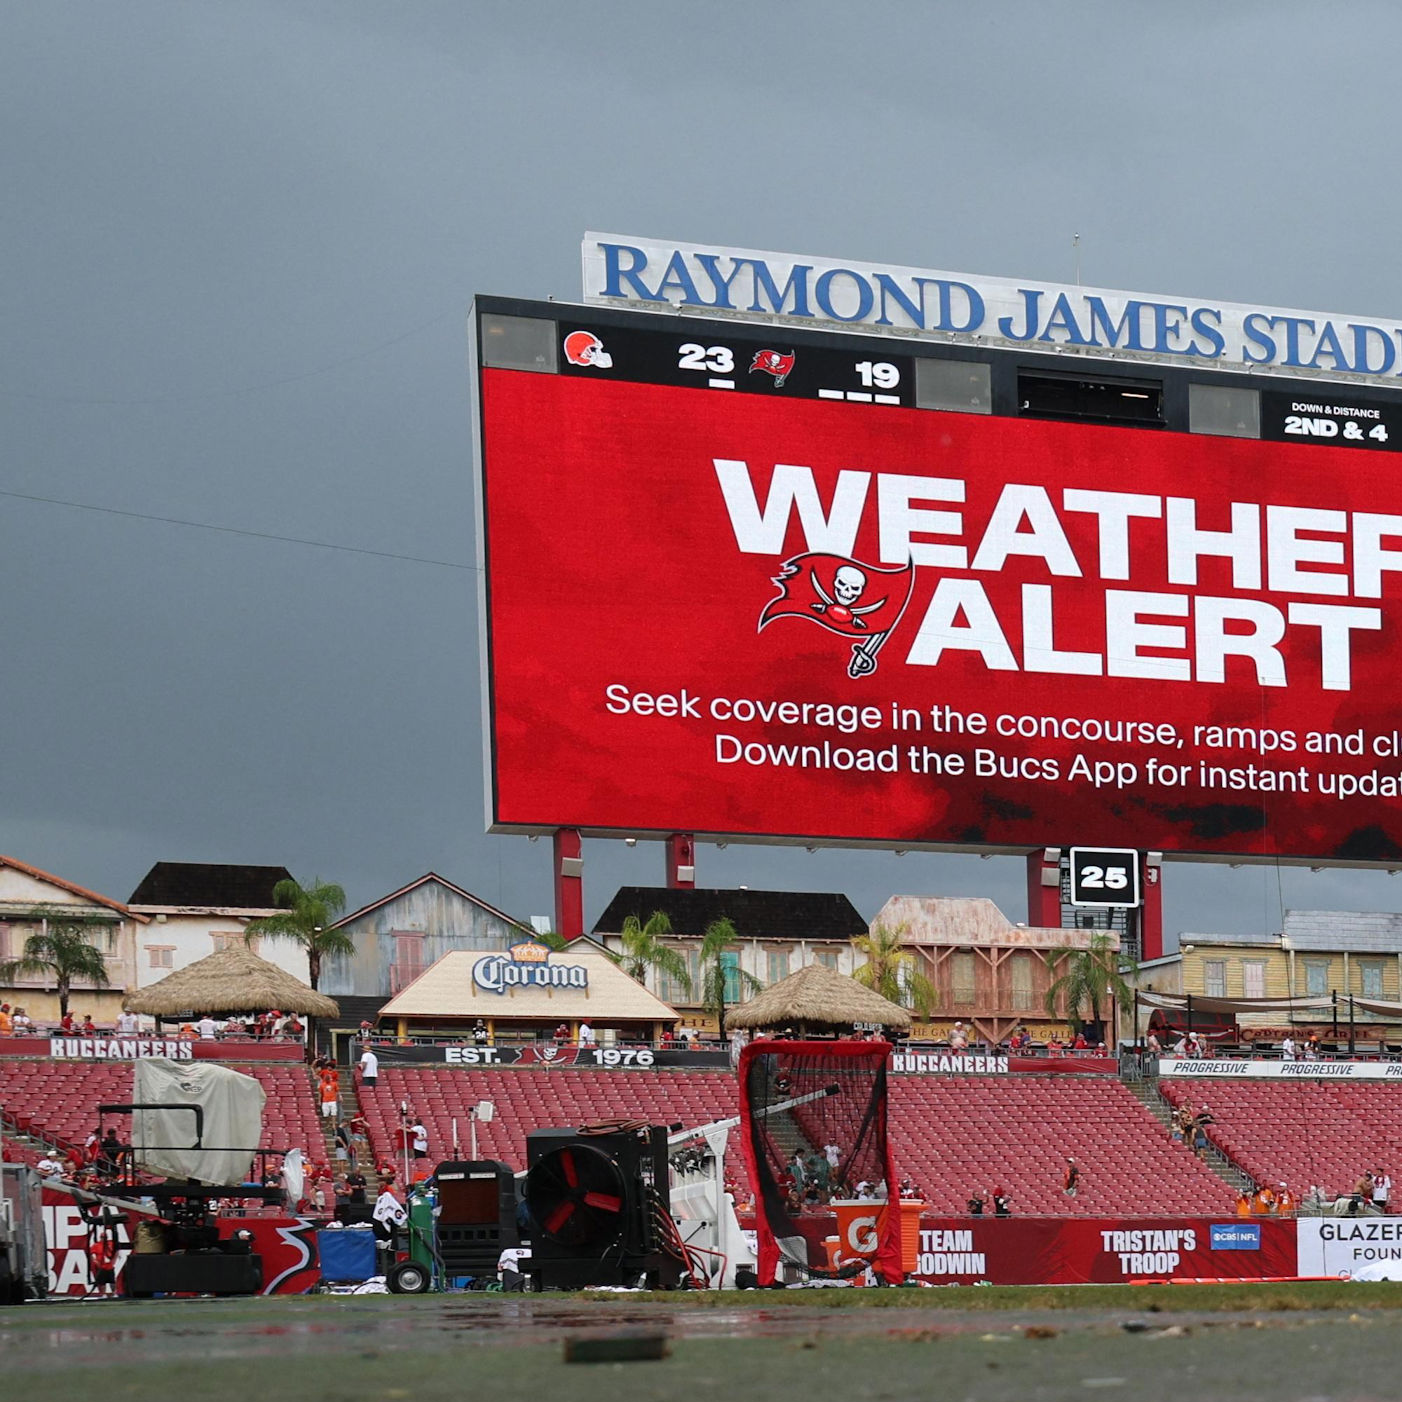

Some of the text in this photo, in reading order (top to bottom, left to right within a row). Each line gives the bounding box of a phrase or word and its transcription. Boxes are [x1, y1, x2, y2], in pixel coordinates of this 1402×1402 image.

[597, 243, 986, 333] RAYMOND
[999, 289, 1225, 359] JAMES
[678, 344, 899, 389] 23 19
[1292, 403, 1380, 419] DOWN DISTANCE
[1284, 416, 1388, 442] 2ND & 4
[905, 577, 1382, 691] ALERT
[605, 684, 702, 719] Seek
[710, 695, 882, 735] coverage
[892, 701, 921, 731] in
[930, 704, 987, 736] the
[995, 712, 1183, 749] concourse,
[1194, 724, 1298, 757] ramps
[1305, 728, 1365, 758] and
[715, 734, 898, 773] Download
[908, 744, 965, 777] the
[975, 748, 1059, 781] Bucs
[1068, 754, 1137, 788] App
[1146, 757, 1191, 786] for
[1199, 760, 1309, 793] instant
[1080, 866, 1128, 889] 25
[472, 955, 588, 993] Corona
[50, 1038, 193, 1060] BUCCANEERS
[445, 1047, 654, 1067] EST. 1976
[893, 1054, 1008, 1073] BUCCANEERS
[1173, 1062, 1249, 1074] PROGRESSIVE
[1280, 1064, 1355, 1075] PROGRESSIVE
[919, 1230, 973, 1252] TEAM
[1101, 1229, 1196, 1252] TRISTAN'S
[1118, 1252, 1180, 1274] TROOP
